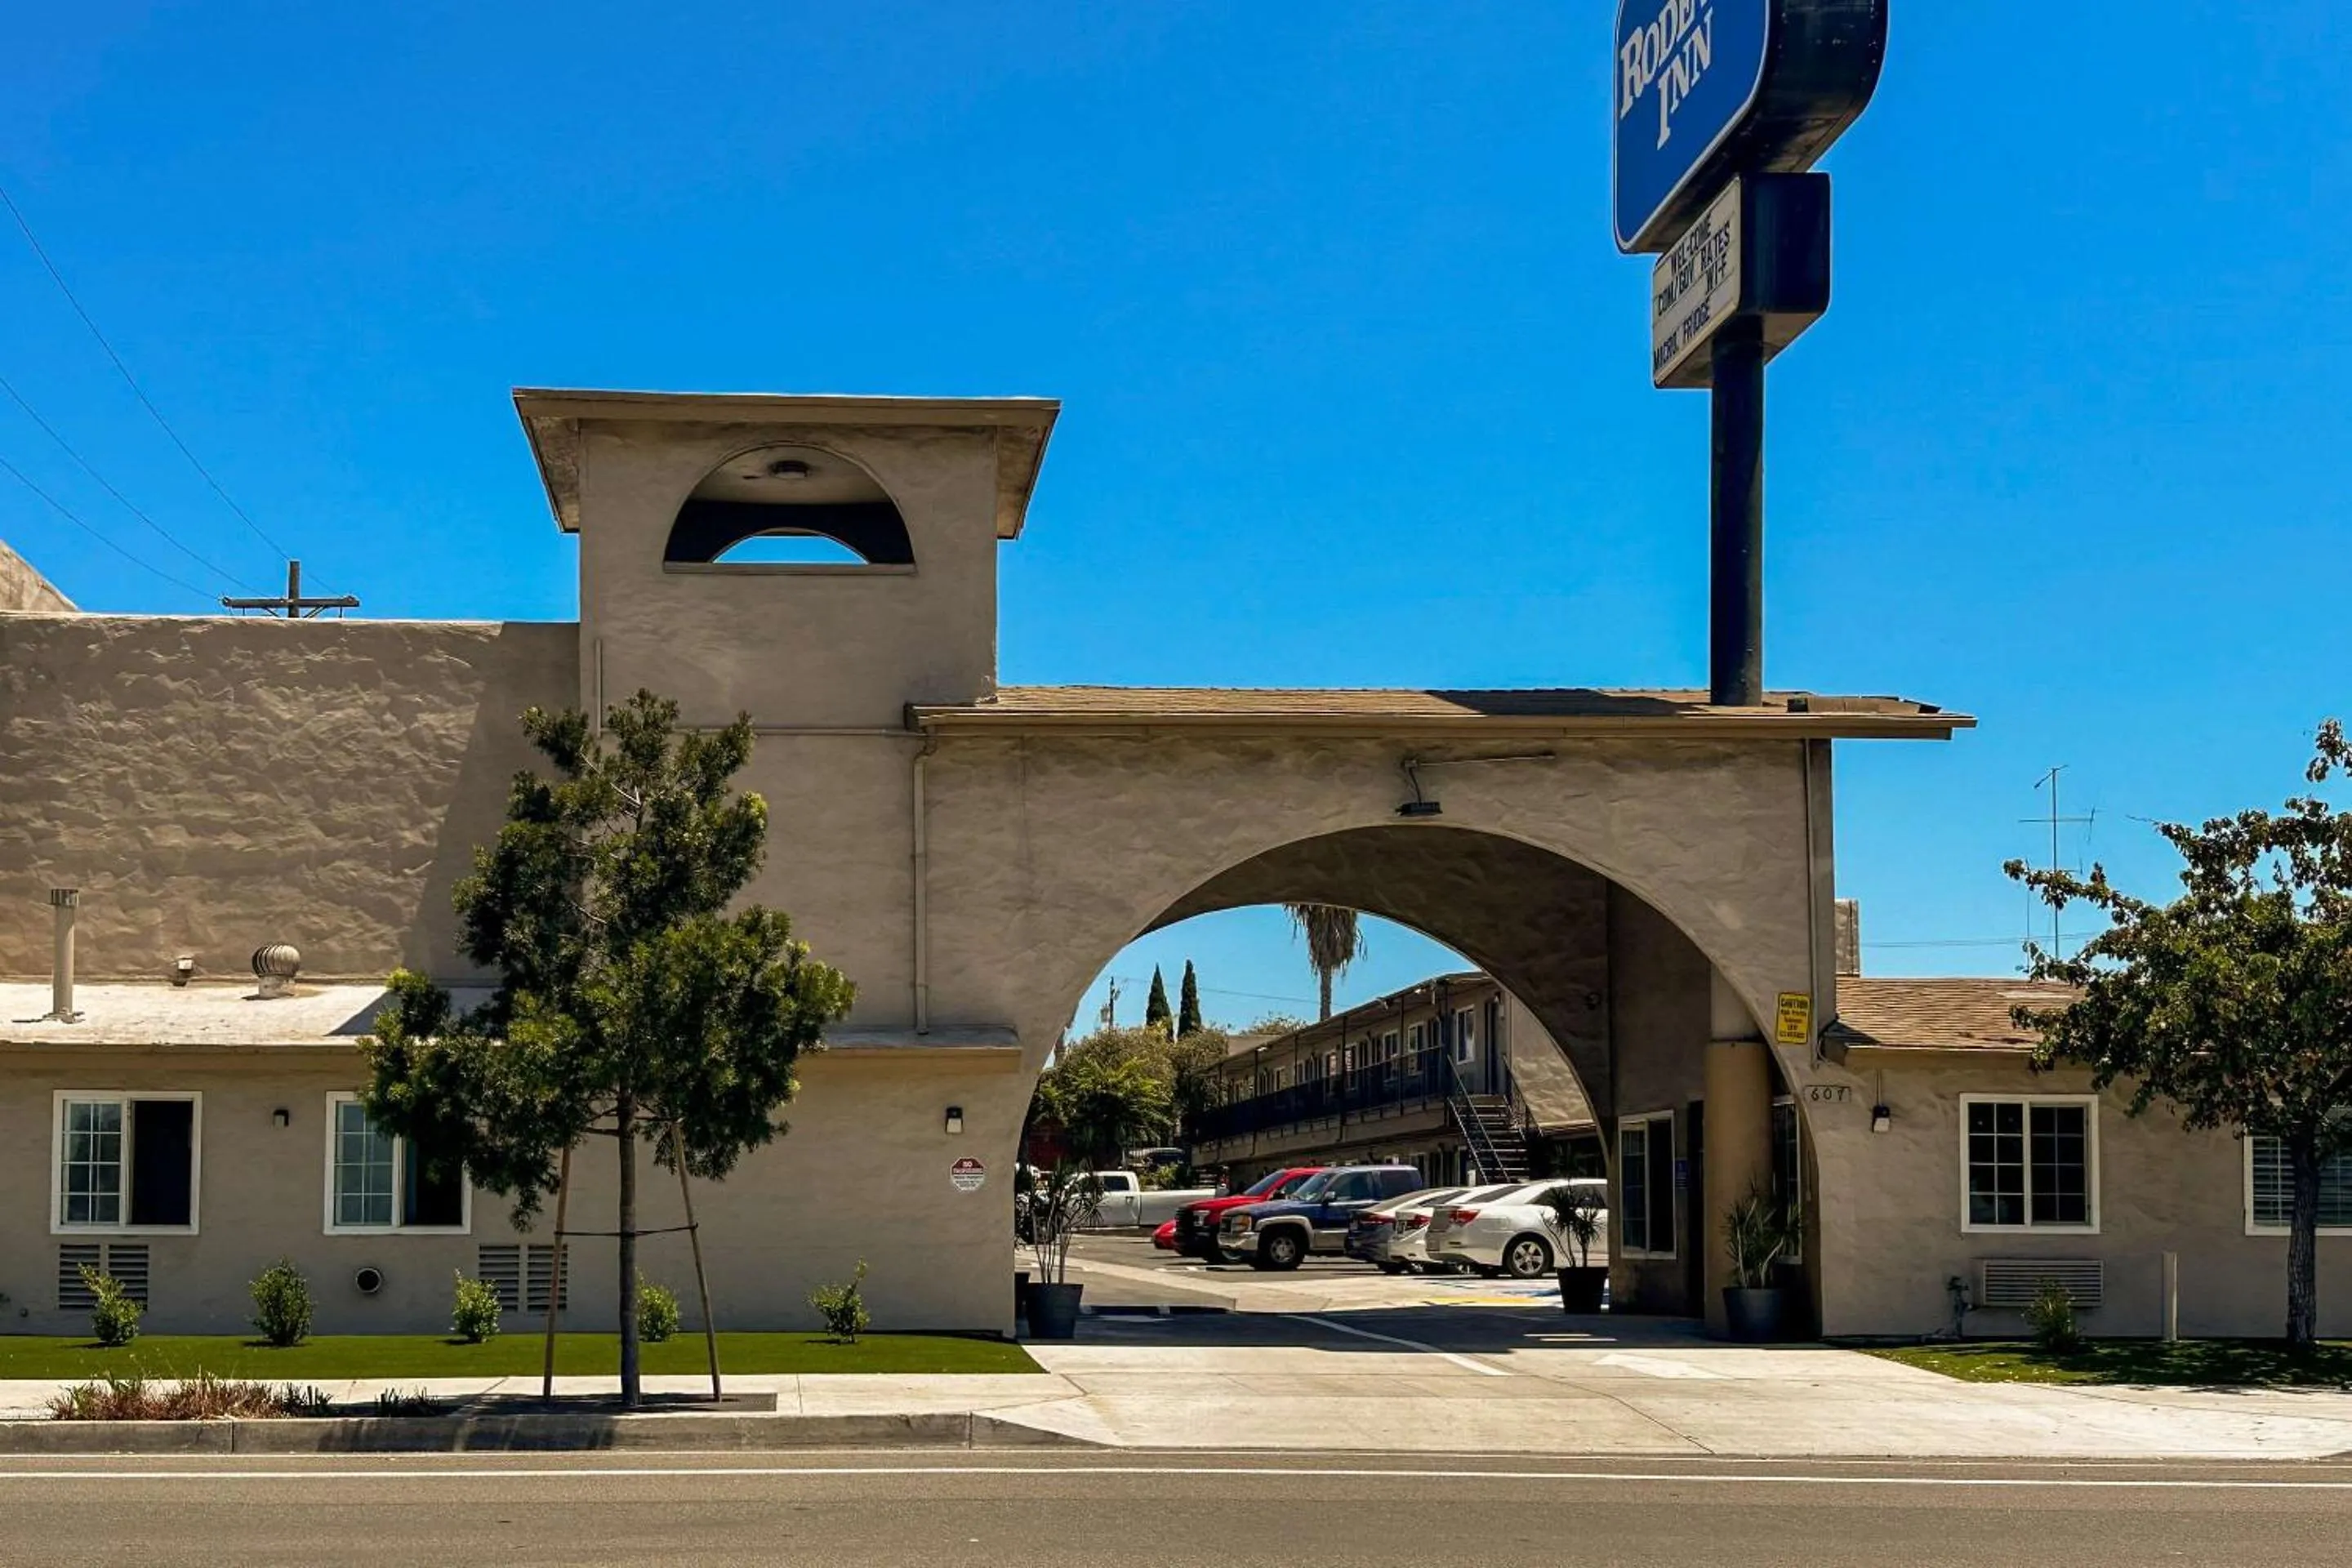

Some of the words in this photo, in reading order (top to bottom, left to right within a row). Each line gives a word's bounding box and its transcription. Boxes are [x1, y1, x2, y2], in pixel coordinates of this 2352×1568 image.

[1620, 0, 1707, 120] RODE
[1657, 7, 1713, 151] INN
[1700, 223, 1731, 272] RATES
[1811, 1087, 1846, 1102] 607
